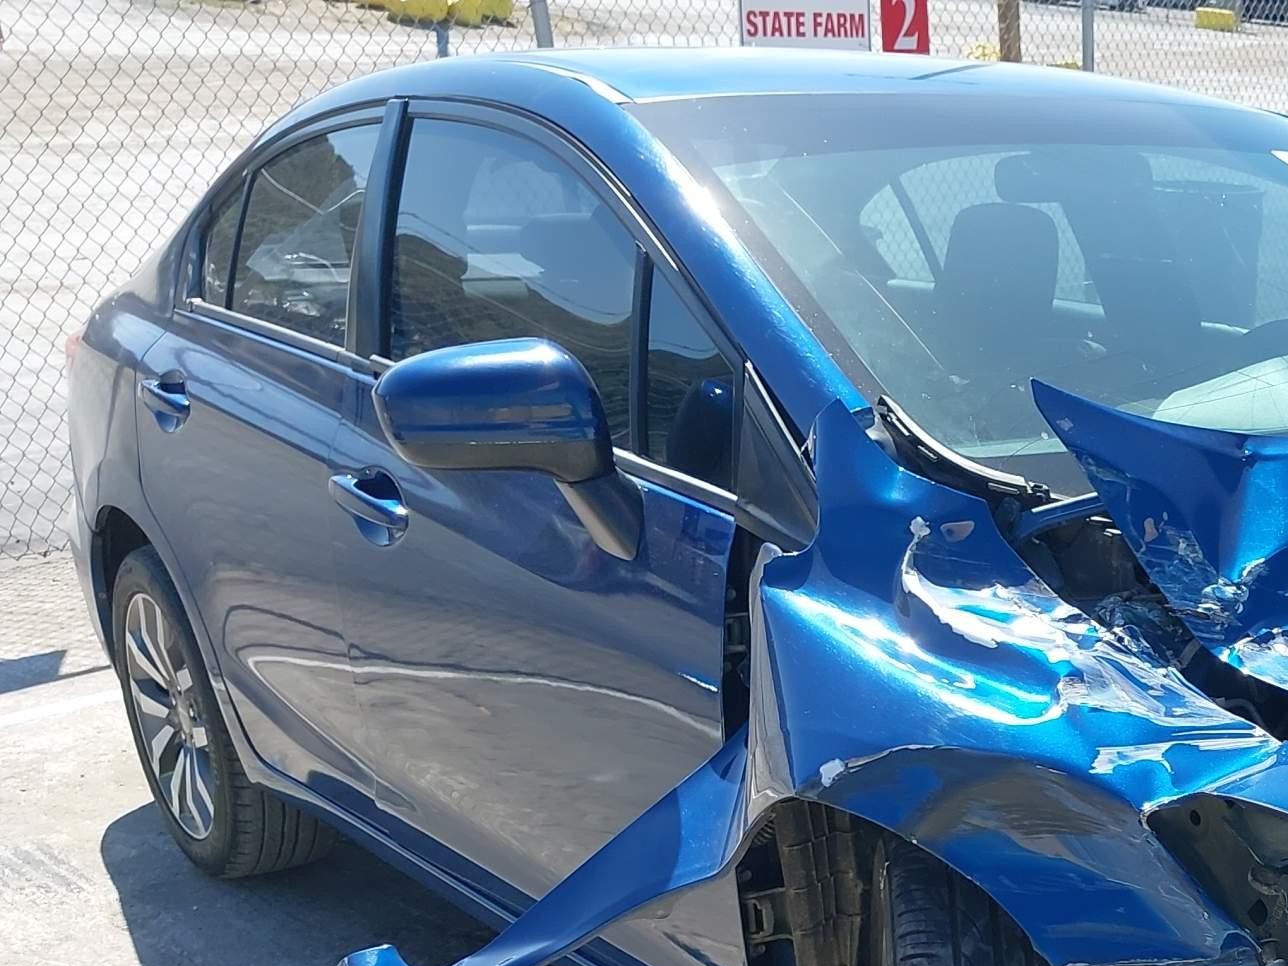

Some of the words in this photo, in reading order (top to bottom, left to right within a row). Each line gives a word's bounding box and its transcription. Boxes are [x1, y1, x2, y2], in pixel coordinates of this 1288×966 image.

[746, 10, 806, 38] STATE
[813, 12, 864, 38] FARM
[892, 0, 919, 51] 2
